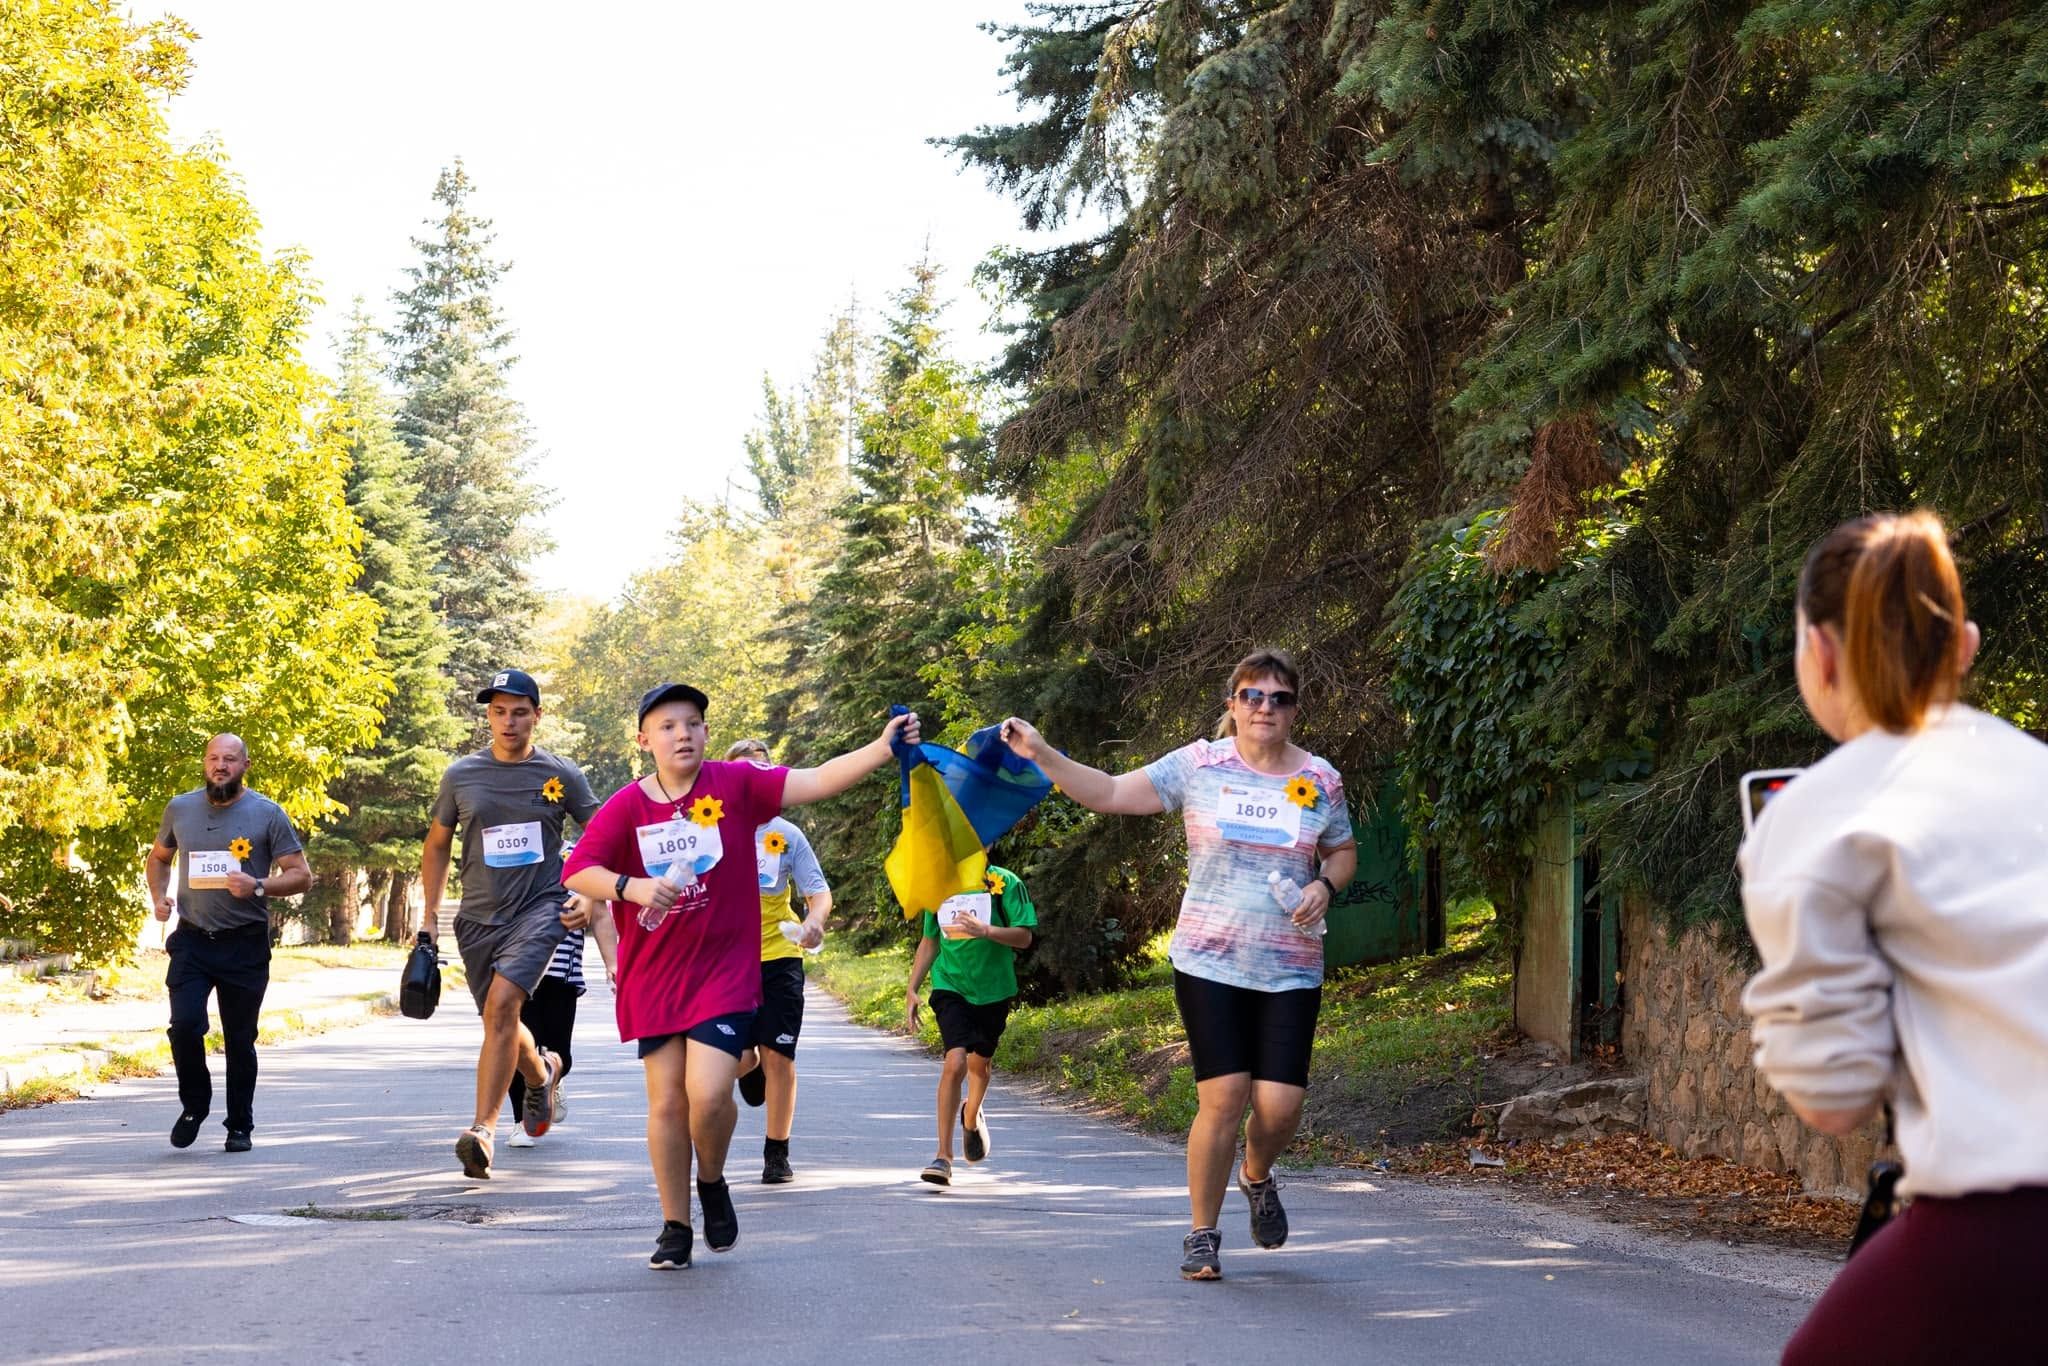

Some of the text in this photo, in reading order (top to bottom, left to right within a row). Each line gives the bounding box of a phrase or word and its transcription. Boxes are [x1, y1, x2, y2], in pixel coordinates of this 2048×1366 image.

[1236, 803, 1278, 819] 1809
[497, 837, 528, 849] 0309
[658, 835, 697, 855] 1809
[201, 863, 227, 872] 1508
